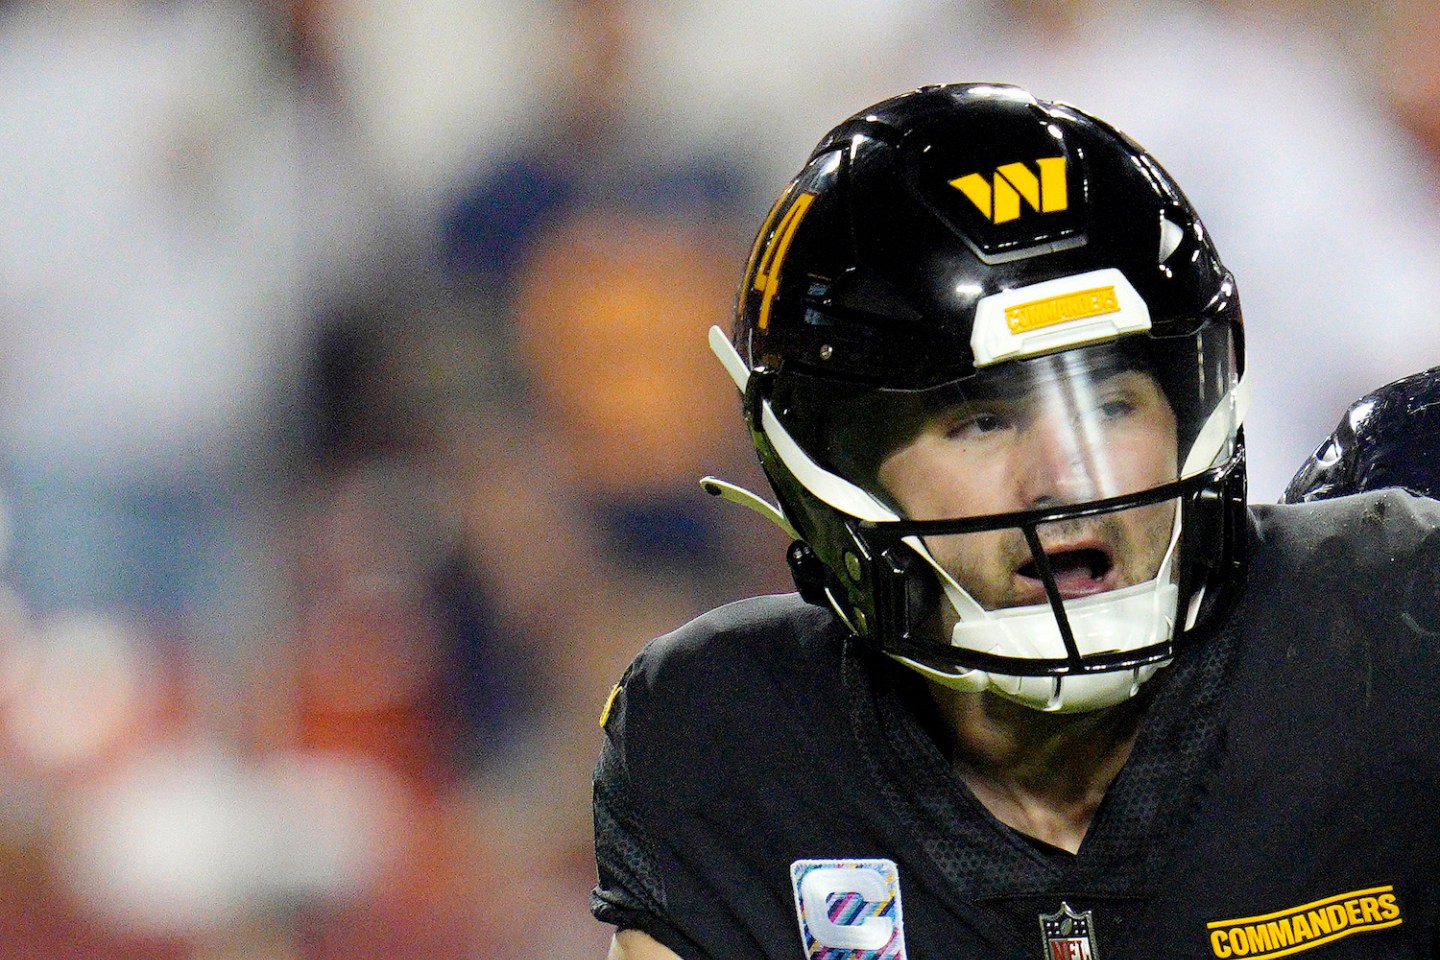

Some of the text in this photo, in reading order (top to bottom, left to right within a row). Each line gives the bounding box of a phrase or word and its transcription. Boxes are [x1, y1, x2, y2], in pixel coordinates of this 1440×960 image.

[1005, 290, 1119, 333] COMMANDERS
[801, 868, 893, 951] C
[1210, 893, 1400, 959] COMMANDERS
